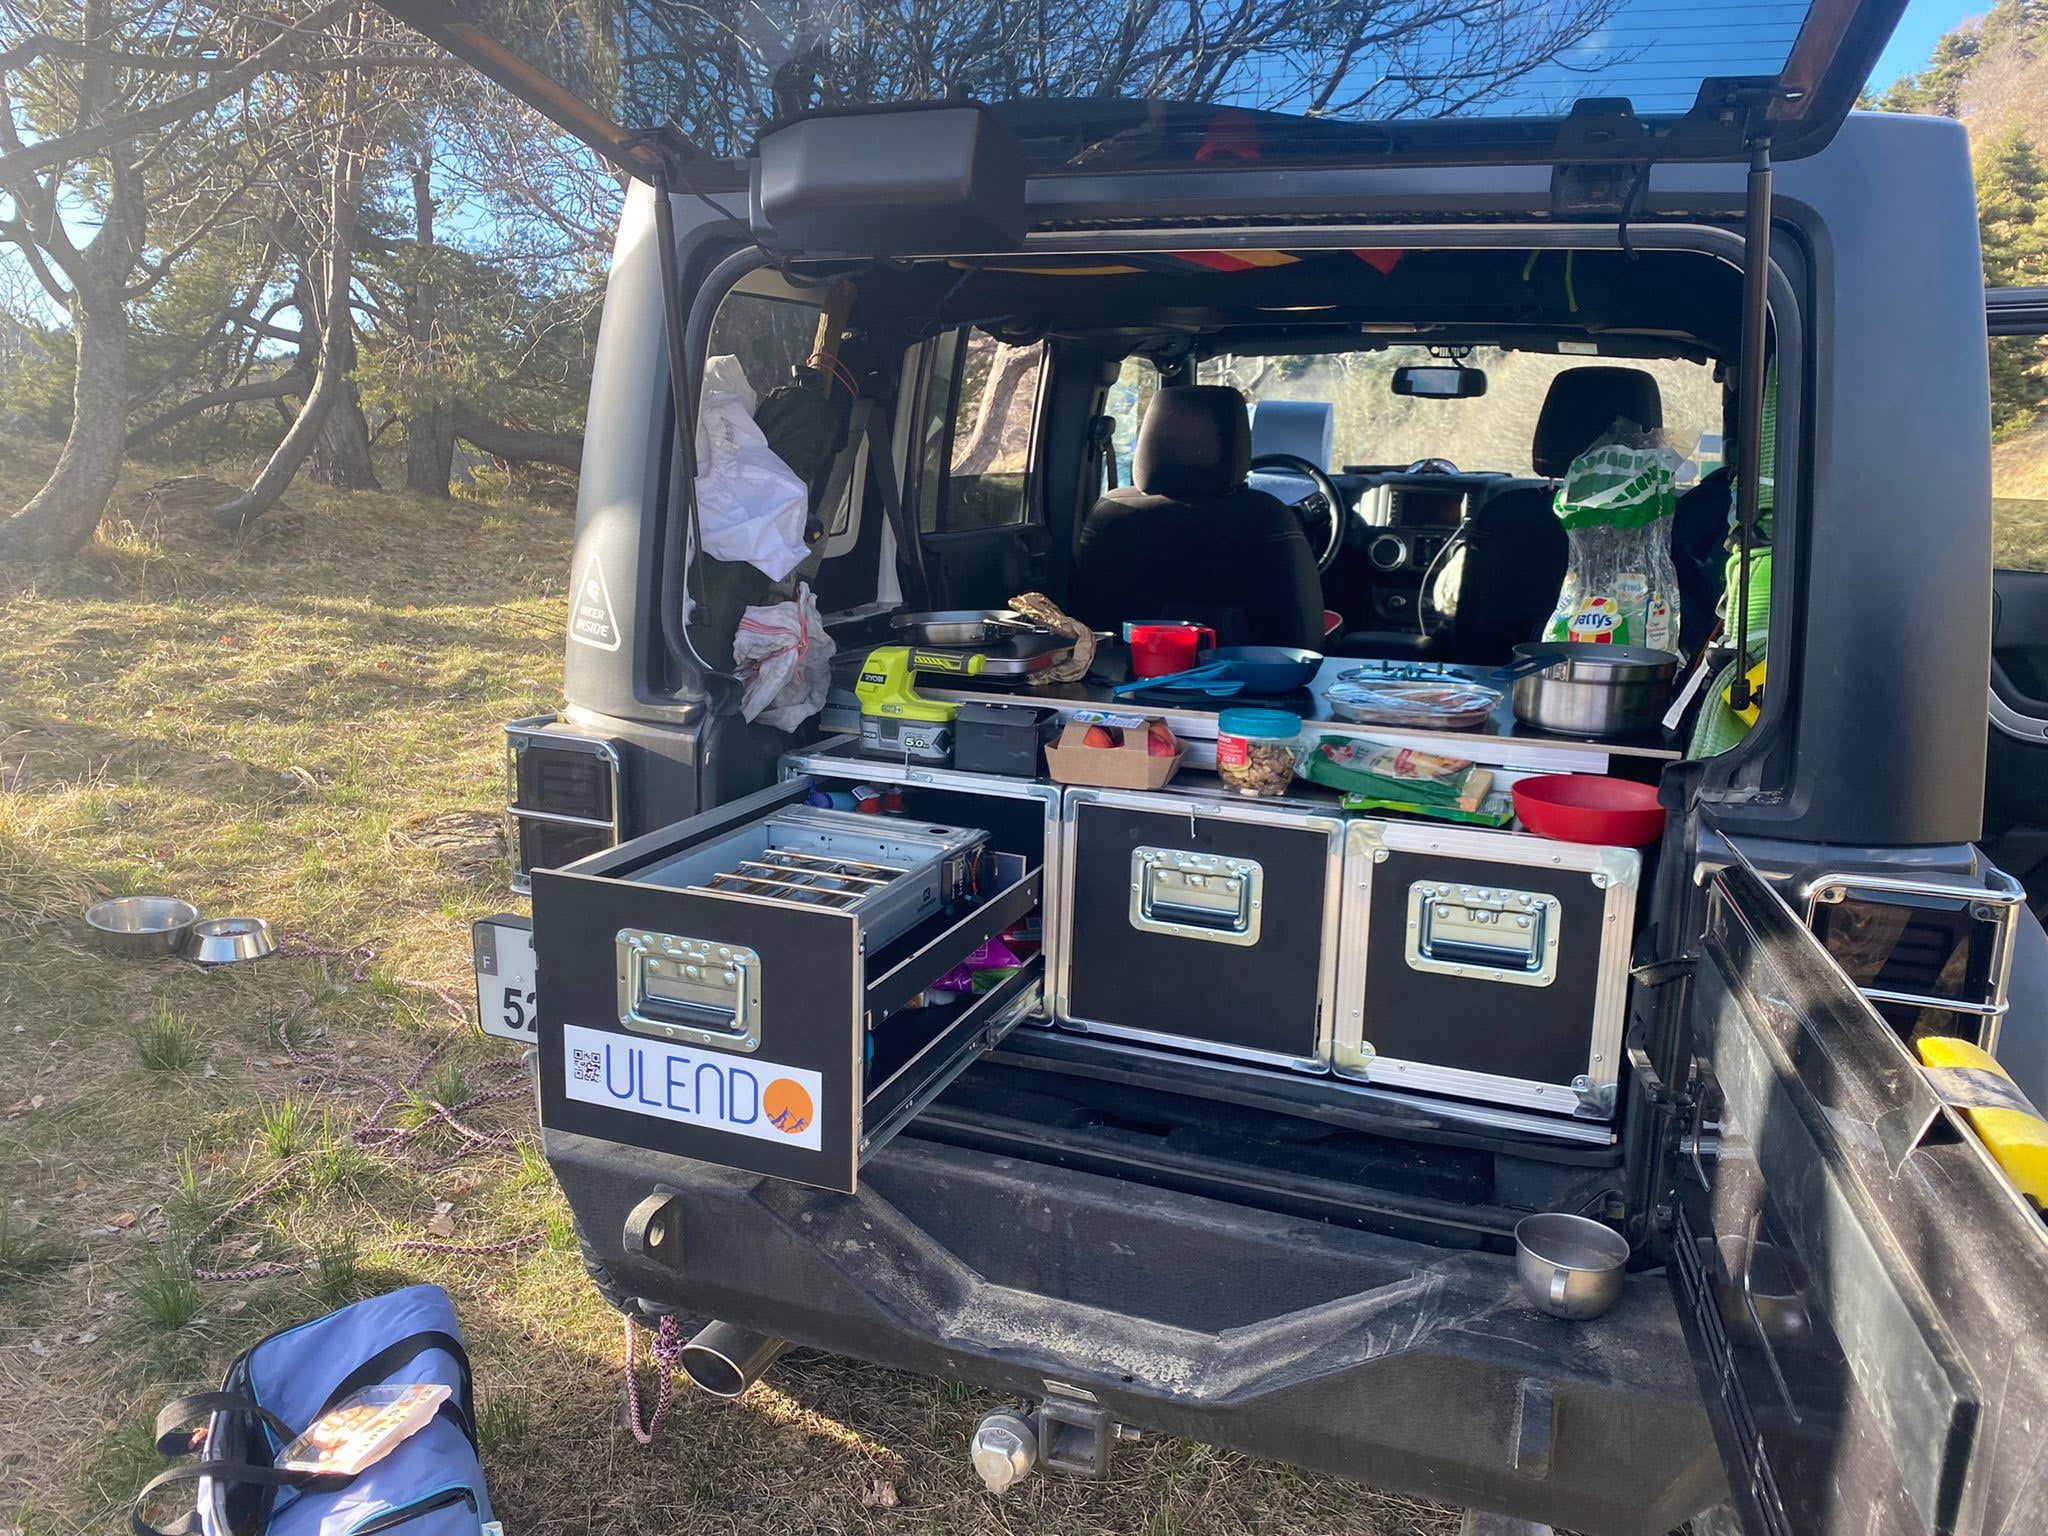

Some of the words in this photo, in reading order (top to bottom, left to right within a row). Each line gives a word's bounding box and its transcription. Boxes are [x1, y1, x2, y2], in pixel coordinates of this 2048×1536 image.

[576, 617, 609, 637] INSIDE
[864, 674, 883, 682] RYOBI
[483, 956, 490, 969] F
